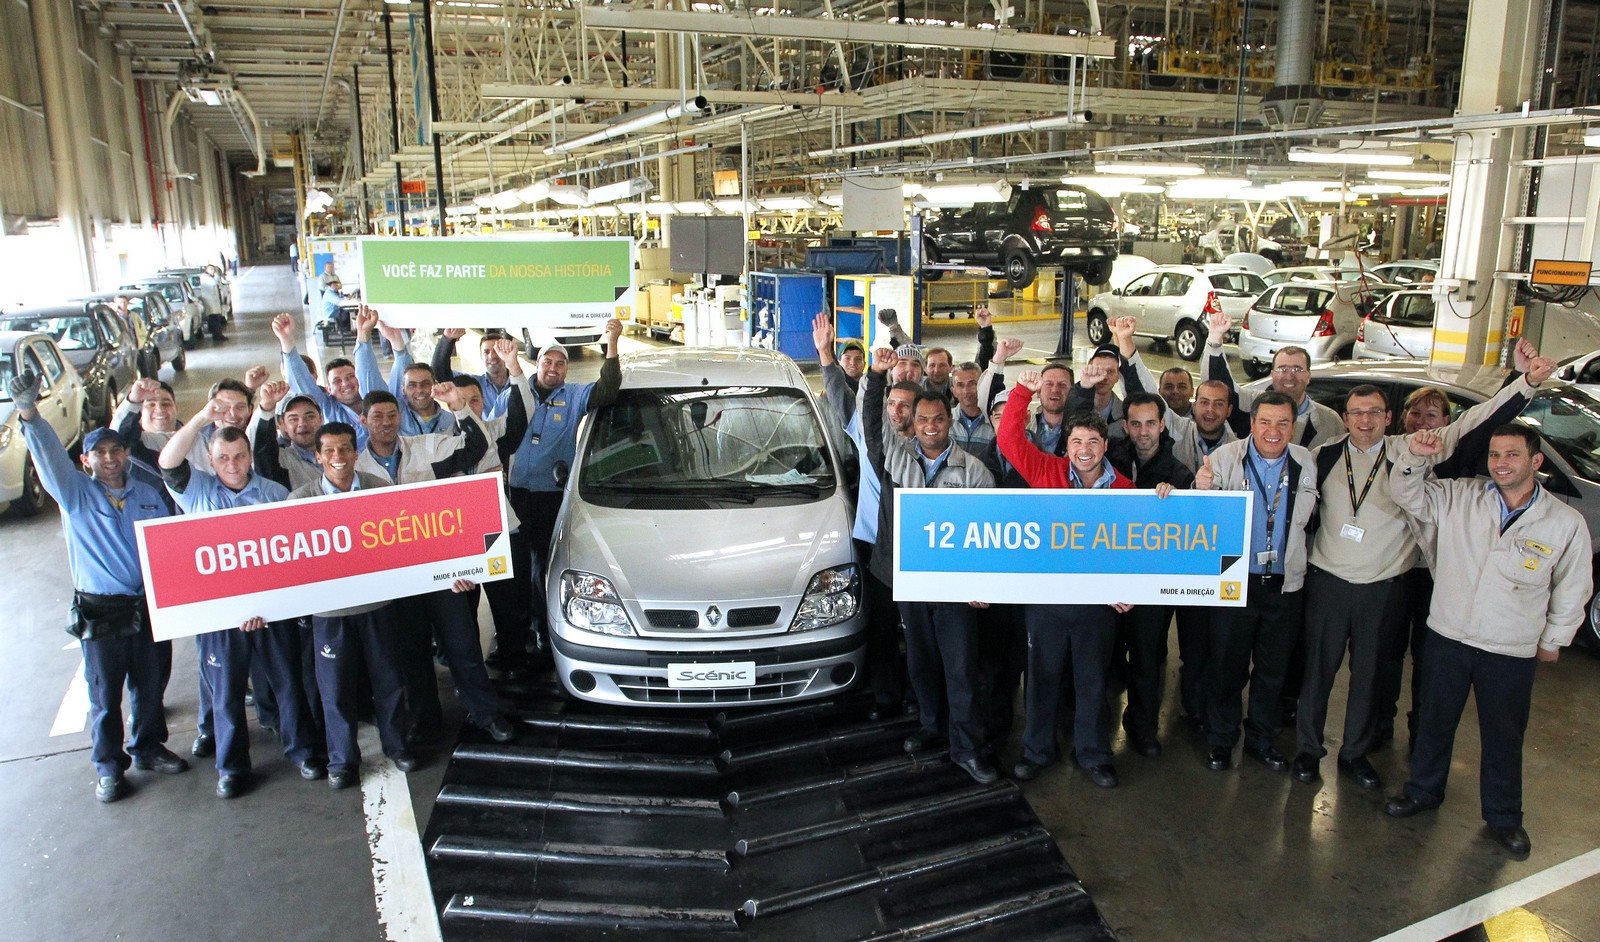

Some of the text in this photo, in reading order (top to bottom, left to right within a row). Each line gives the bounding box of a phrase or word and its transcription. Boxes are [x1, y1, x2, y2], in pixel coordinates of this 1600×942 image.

[382, 261, 612, 278] VOCÊ FAZ PARTE DA NOSSA HISTÓRIA
[1537, 269, 1586, 277] FUNCIONAMENTO
[194, 508, 464, 576] OBRIGADO SCÉNIC!
[923, 521, 1218, 551] 12 ANOS DE ALEGRIA!
[433, 572, 451, 581] MUDE
[457, 566, 484, 577] DIREÇÃO
[1186, 588, 1215, 597] DIREÇÃO
[677, 670, 747, 681] Scénic
